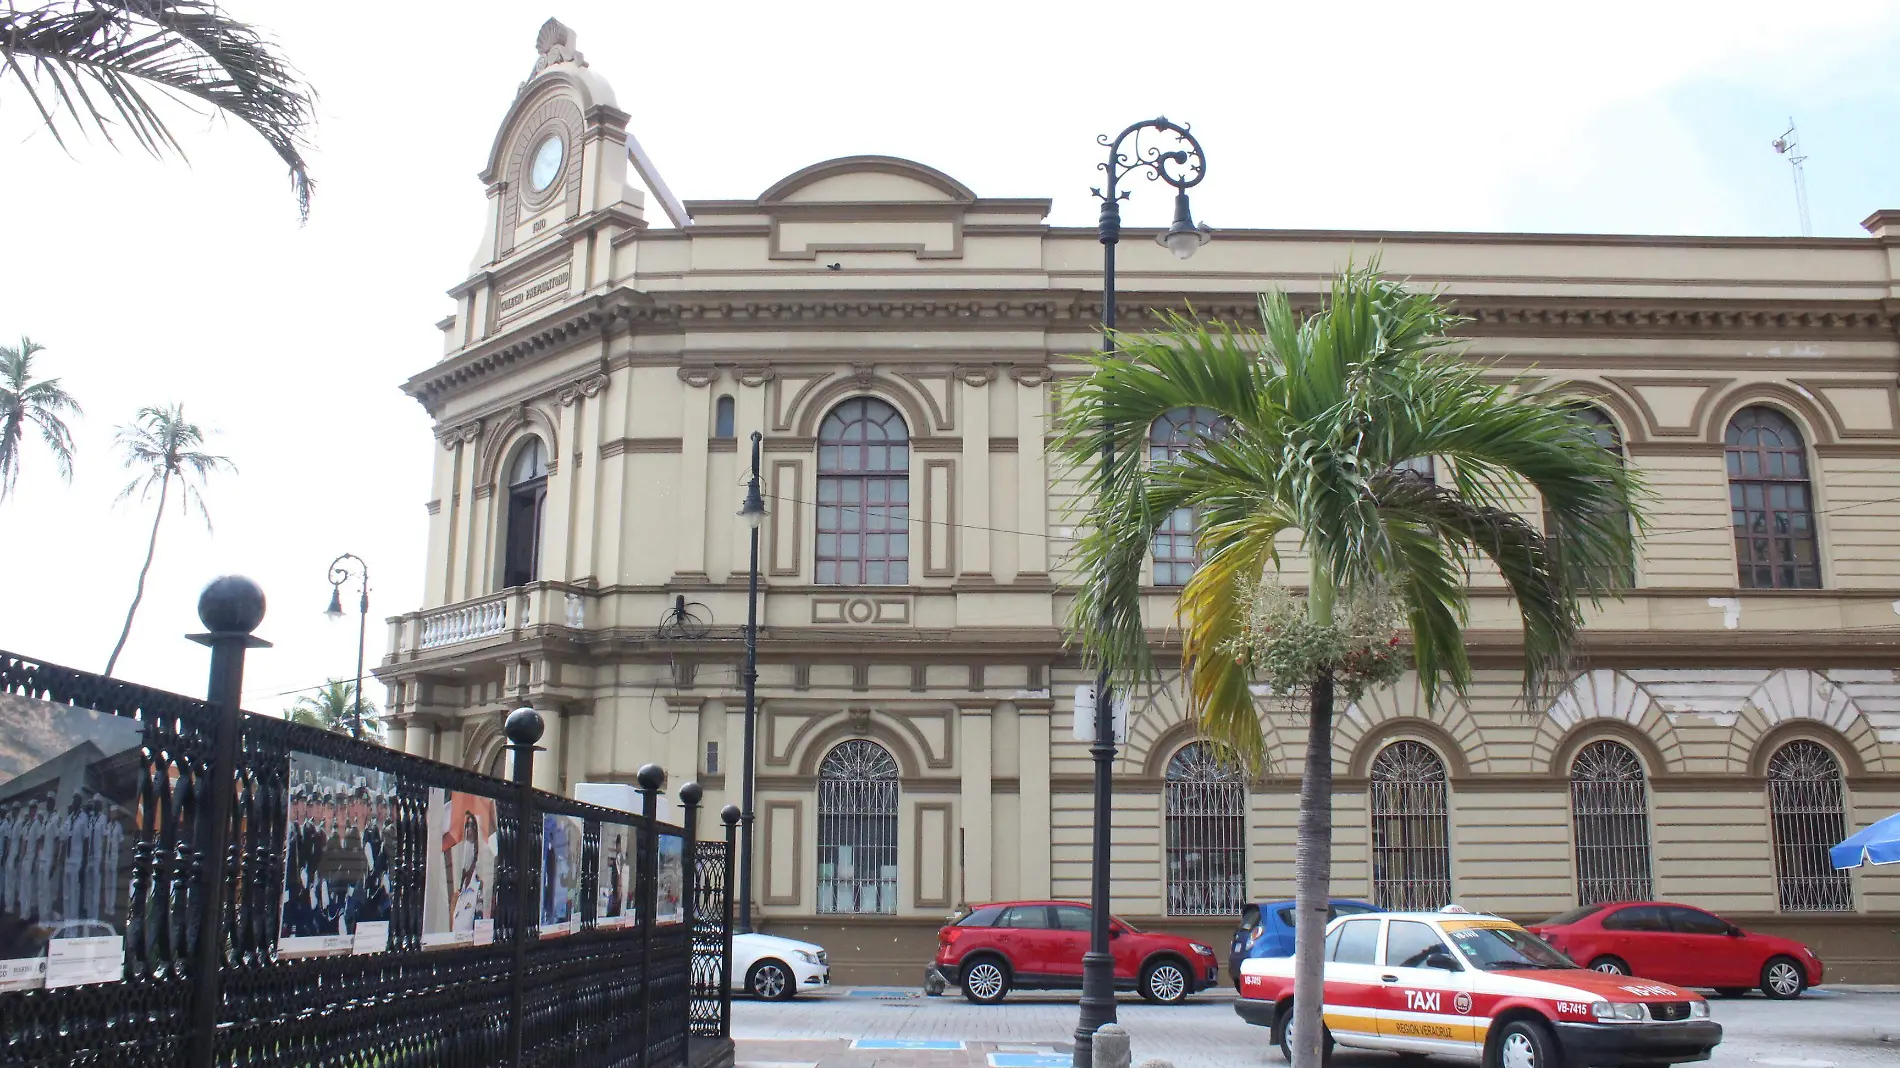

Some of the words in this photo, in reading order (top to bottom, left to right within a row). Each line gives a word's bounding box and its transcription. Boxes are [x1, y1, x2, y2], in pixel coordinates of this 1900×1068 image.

[1245, 976, 1261, 985] VB-7415
[1404, 989, 1441, 1011] TAXI
[1556, 1001, 1587, 1015] VB-7415
[1396, 1022, 1420, 1035] REGION
[1419, 1025, 1453, 1038] VERACRUZ
